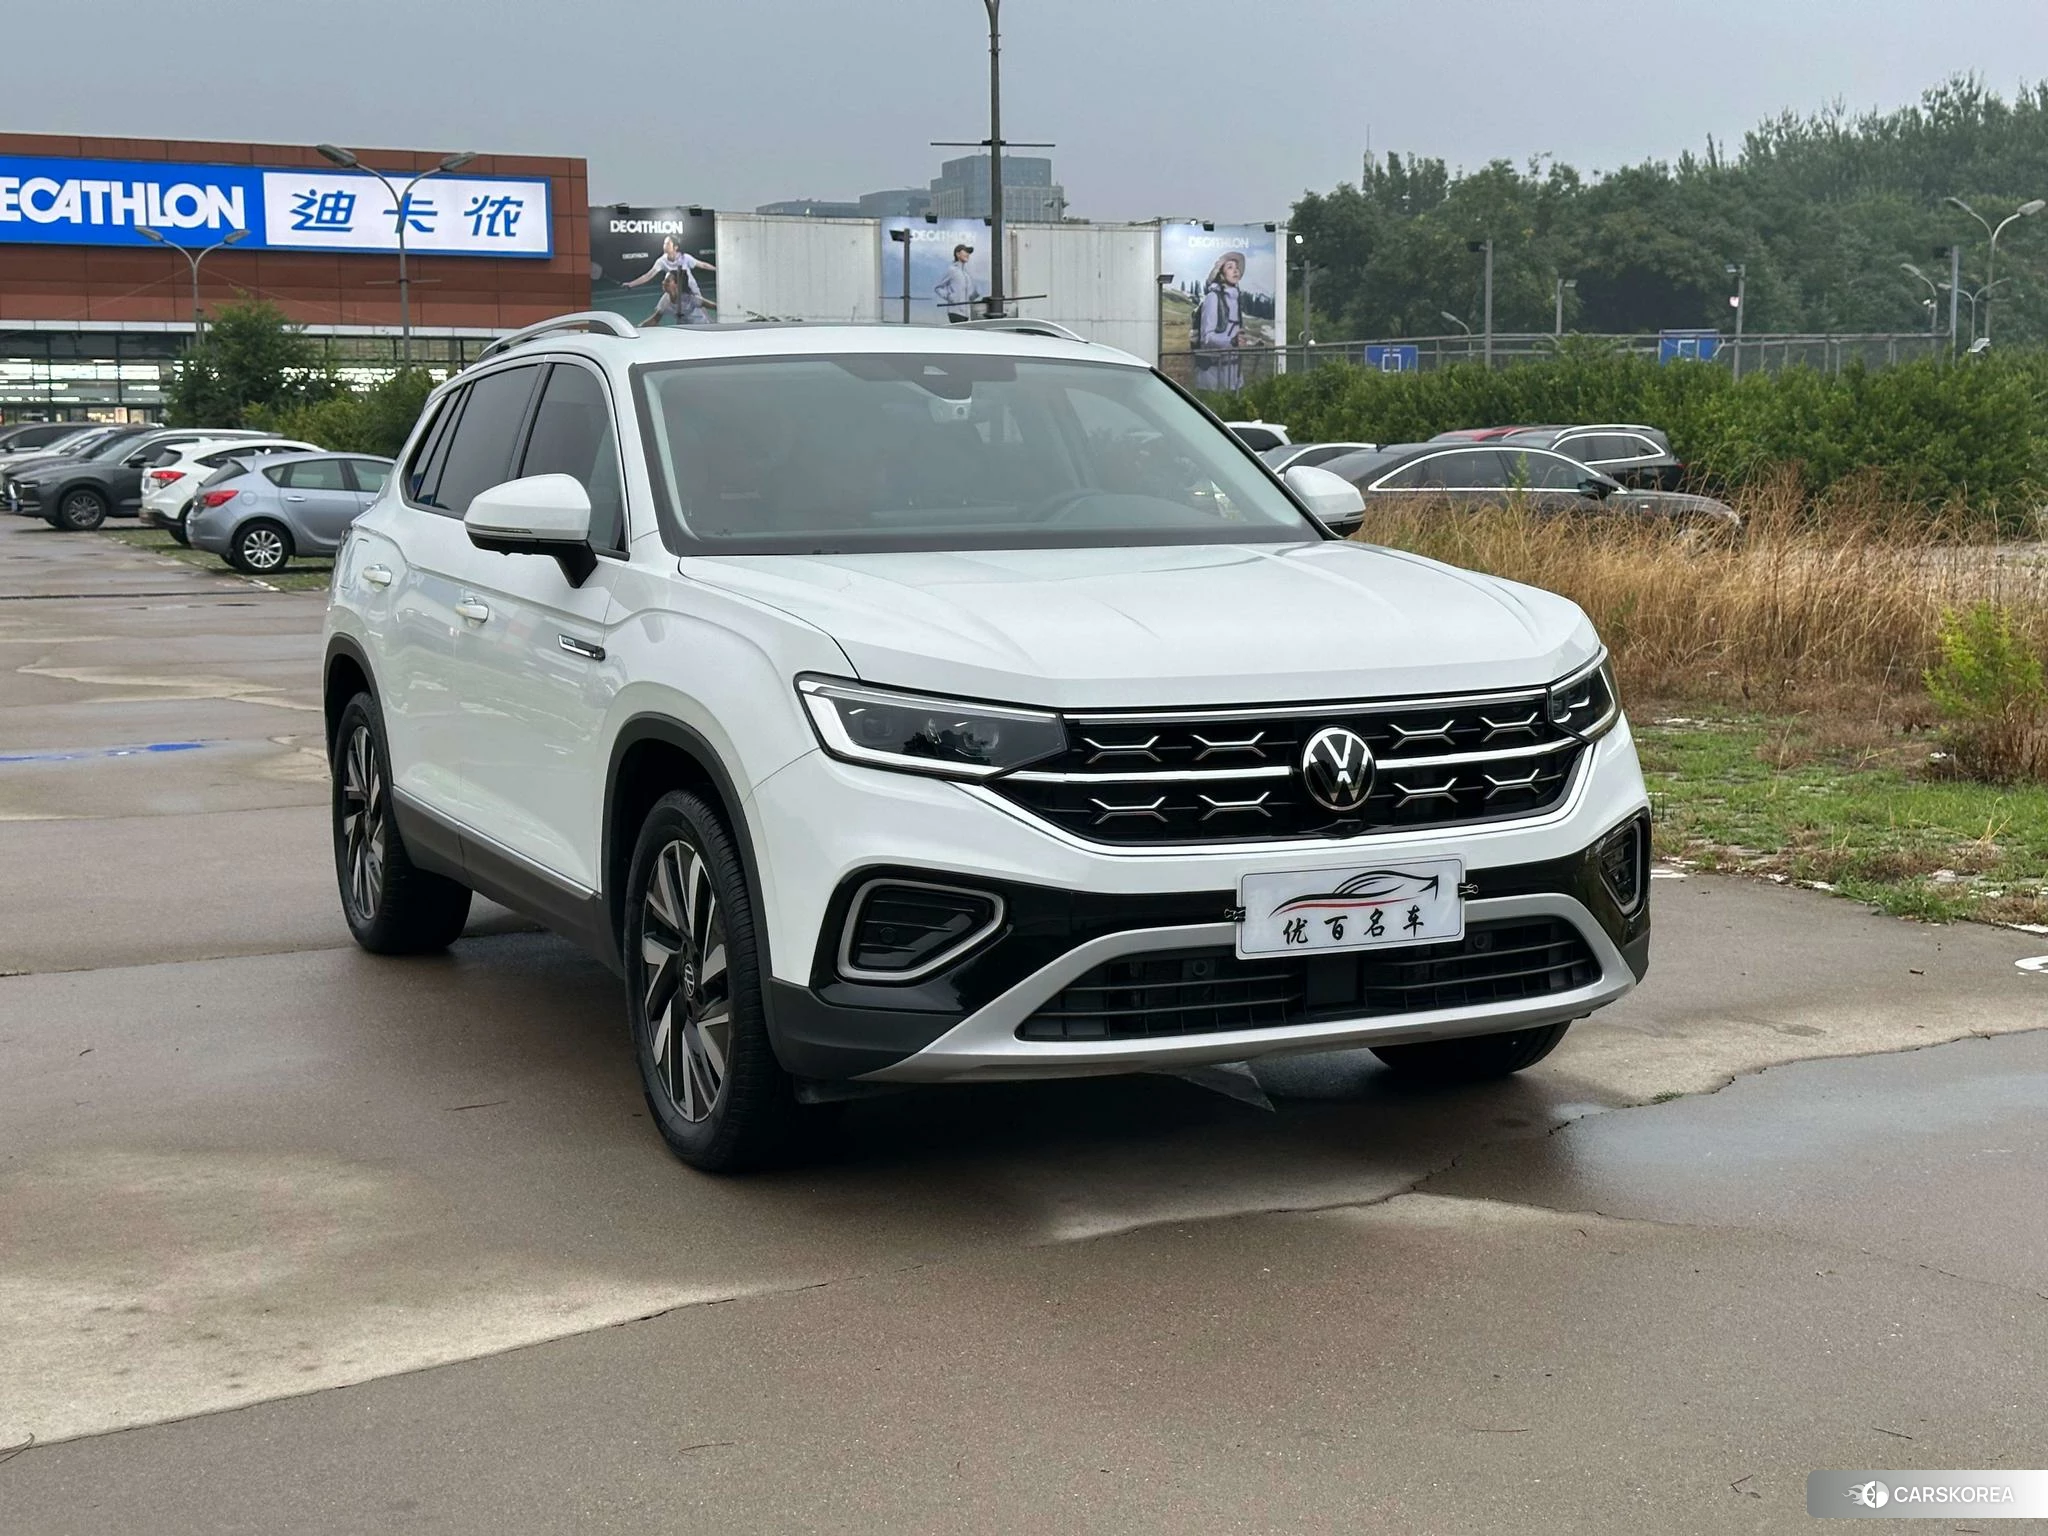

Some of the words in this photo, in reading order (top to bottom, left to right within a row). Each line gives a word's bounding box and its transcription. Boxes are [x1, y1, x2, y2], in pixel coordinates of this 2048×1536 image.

[289, 188, 524, 237] 迪卡侬
[610, 220, 684, 234] DECATHLON
[1189, 236, 1249, 249] DECATHLON
[1283, 904, 1425, 946] 优百名车
